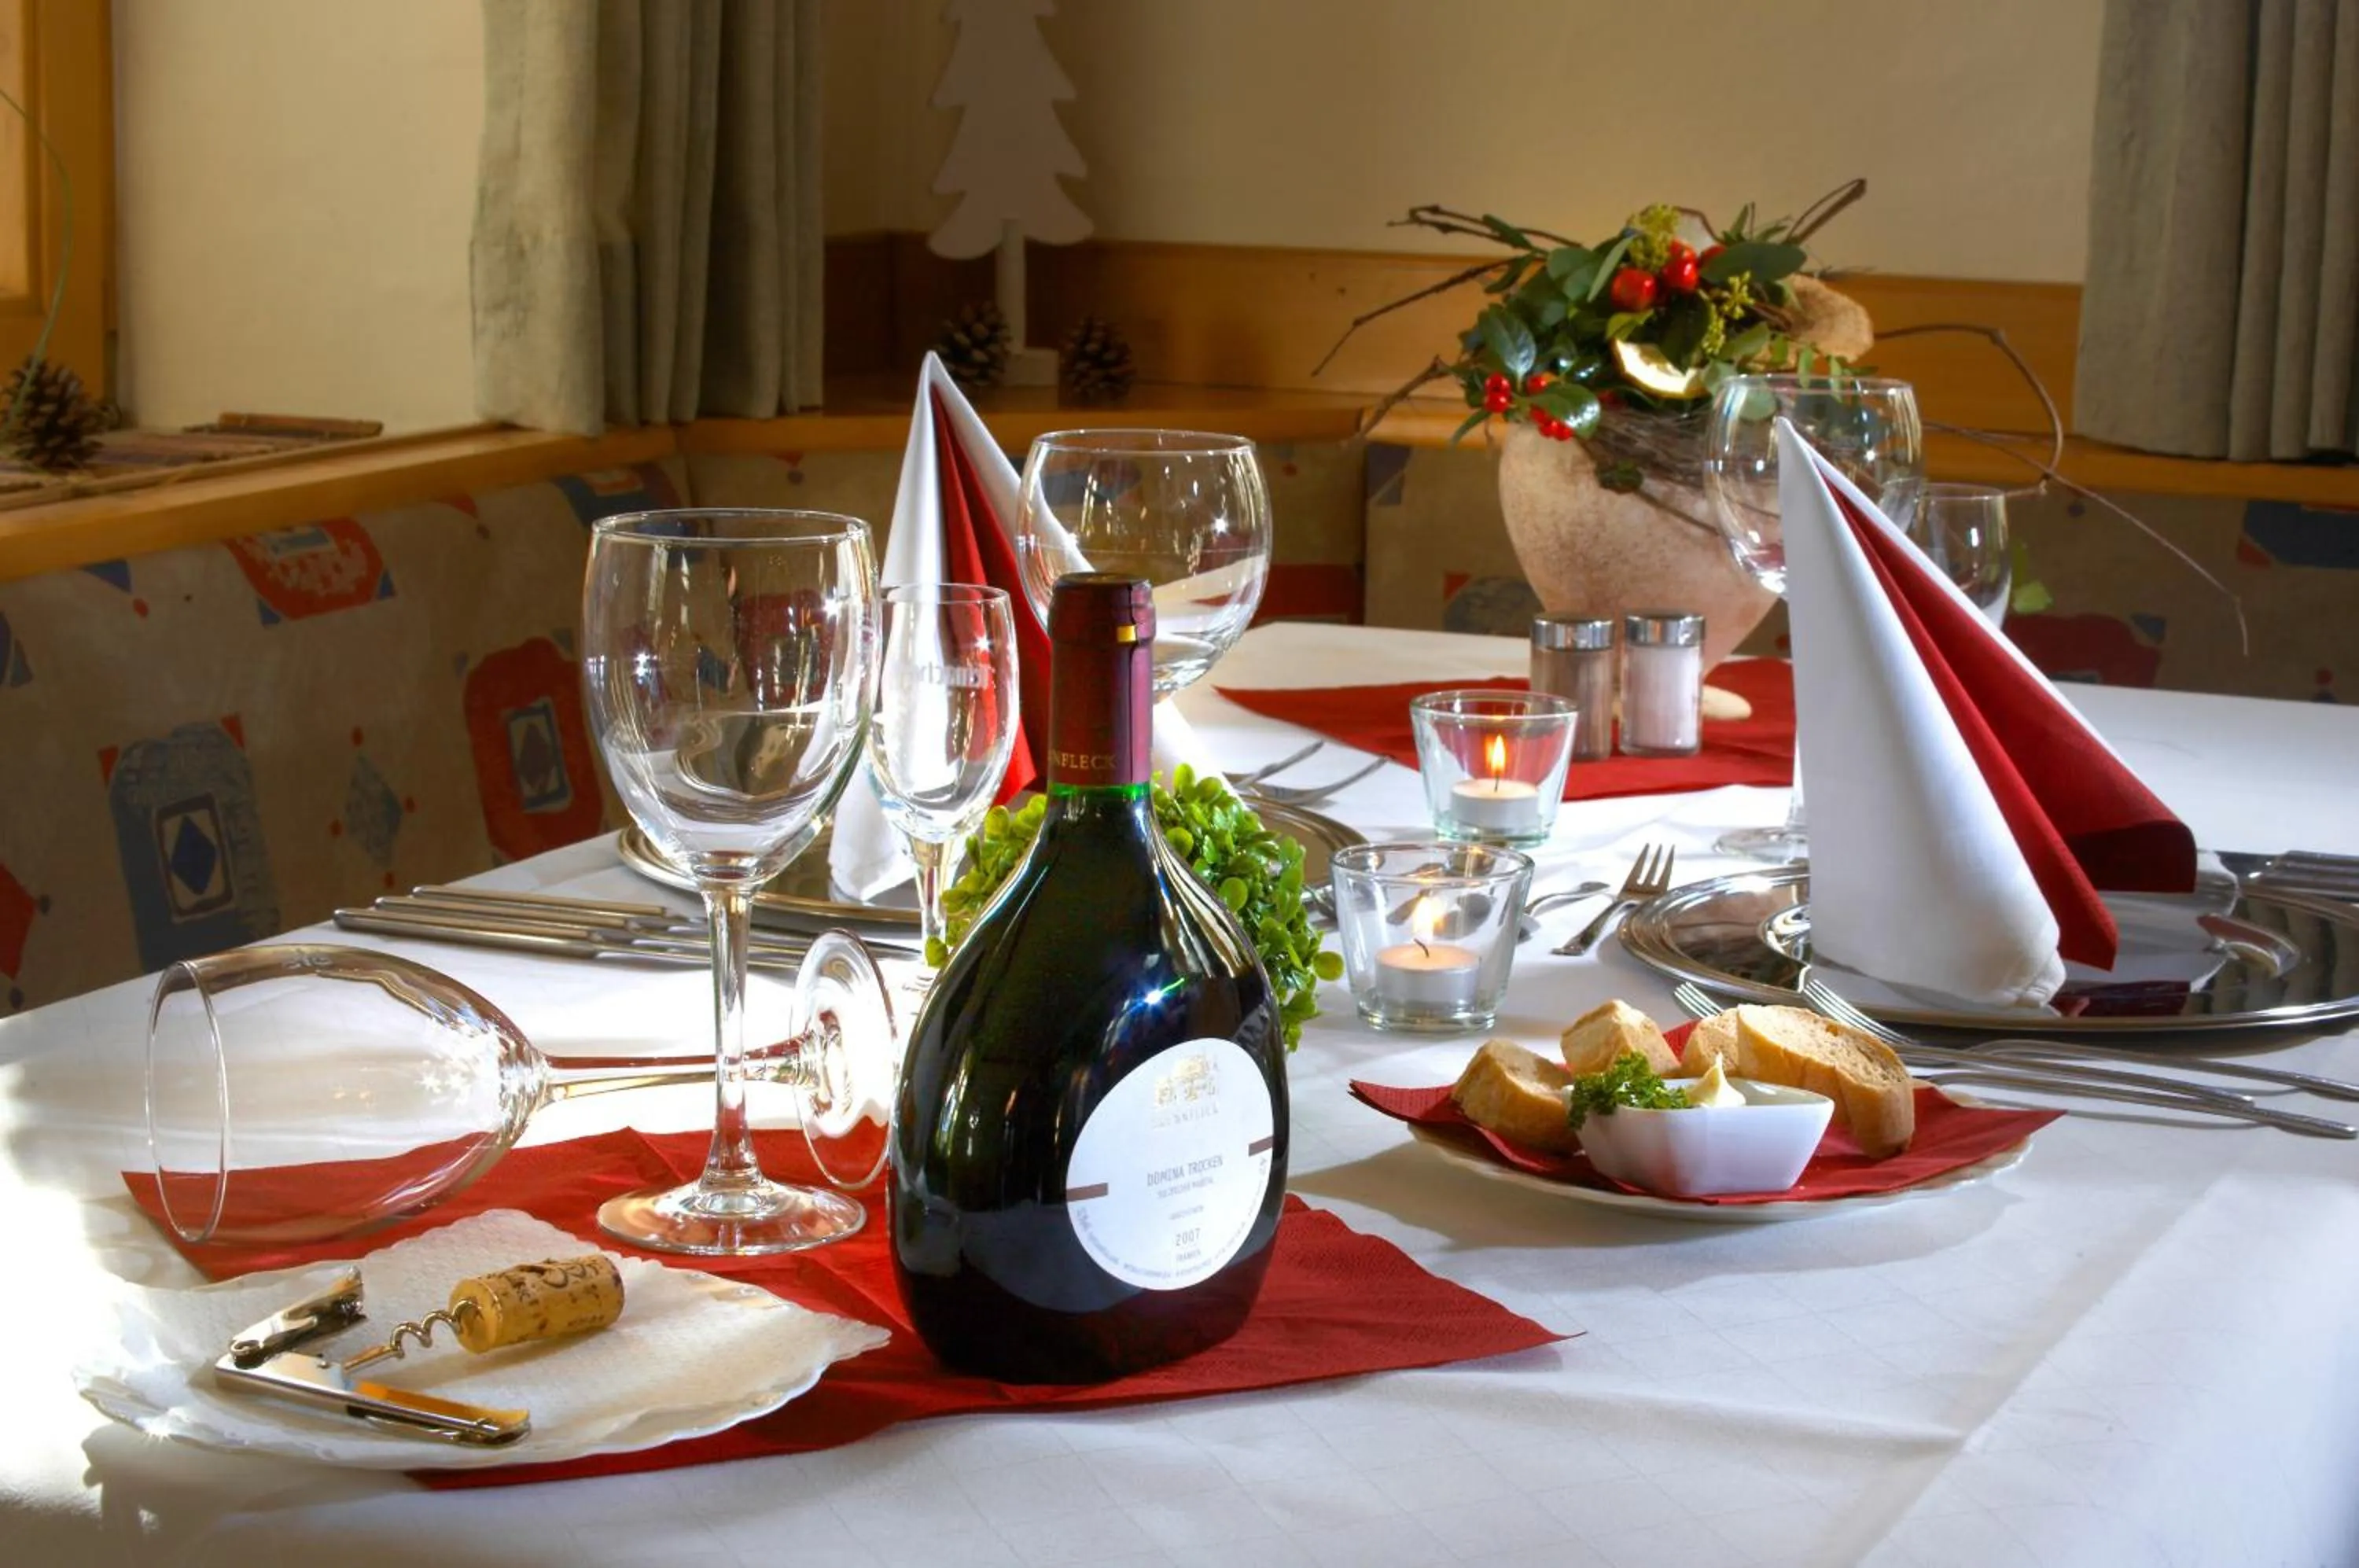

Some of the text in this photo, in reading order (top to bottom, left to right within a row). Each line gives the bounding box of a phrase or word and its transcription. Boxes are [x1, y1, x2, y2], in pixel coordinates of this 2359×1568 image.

[1146, 1165, 1186, 1187] DOMINA
[1188, 1155, 1224, 1177] TROCKEN
[1175, 1228, 1202, 1247] 2007
